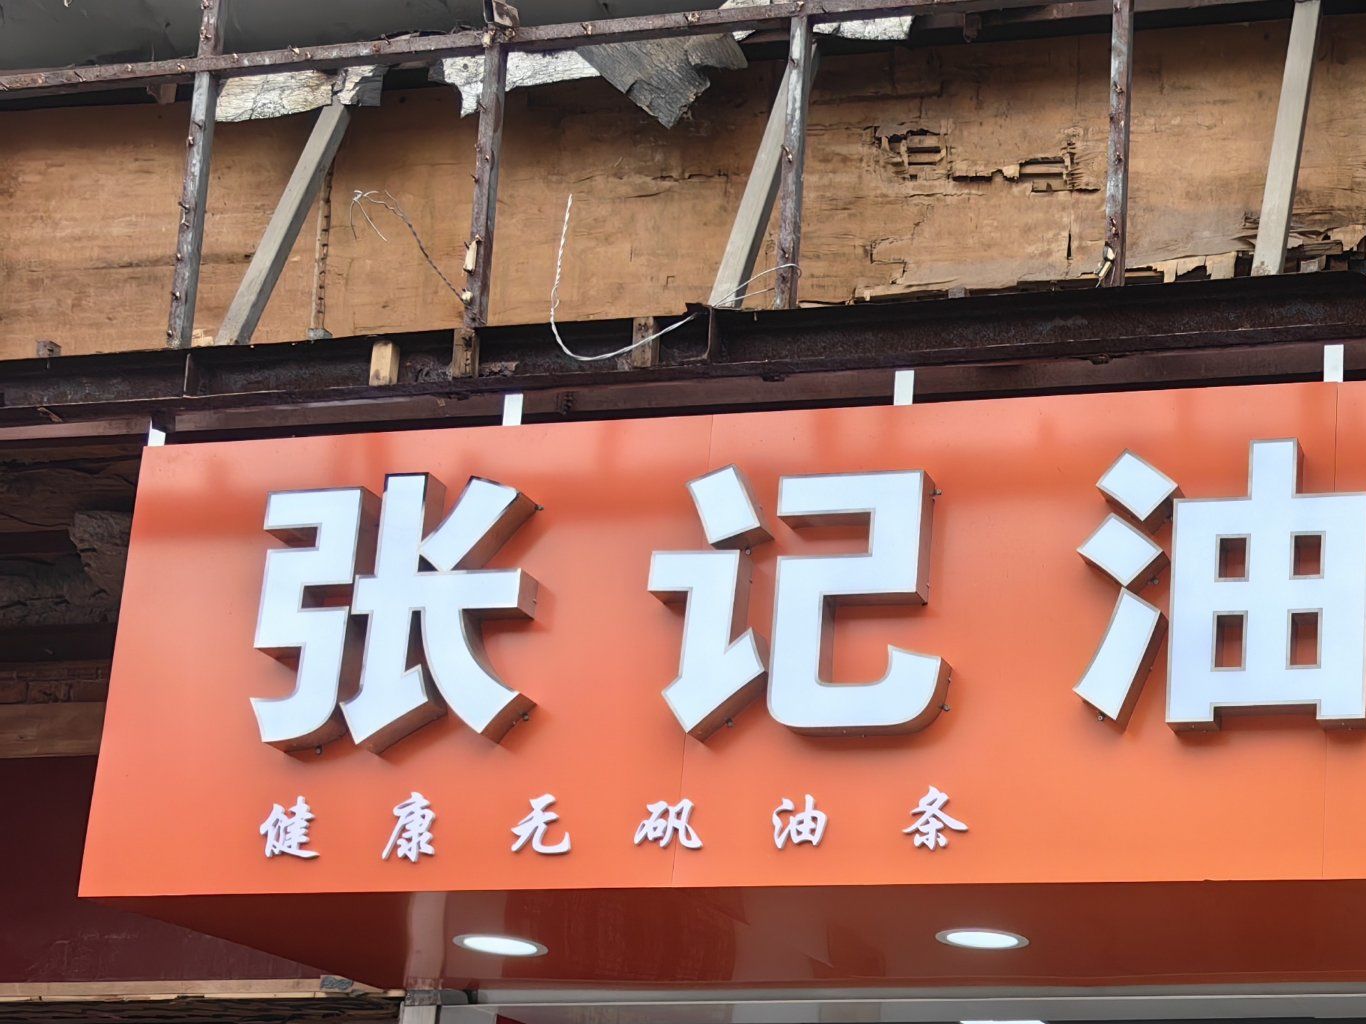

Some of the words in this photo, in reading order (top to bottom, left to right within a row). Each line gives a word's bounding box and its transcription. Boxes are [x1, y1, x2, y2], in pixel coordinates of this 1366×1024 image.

[260, 786, 968, 860] 健康无矾油条
